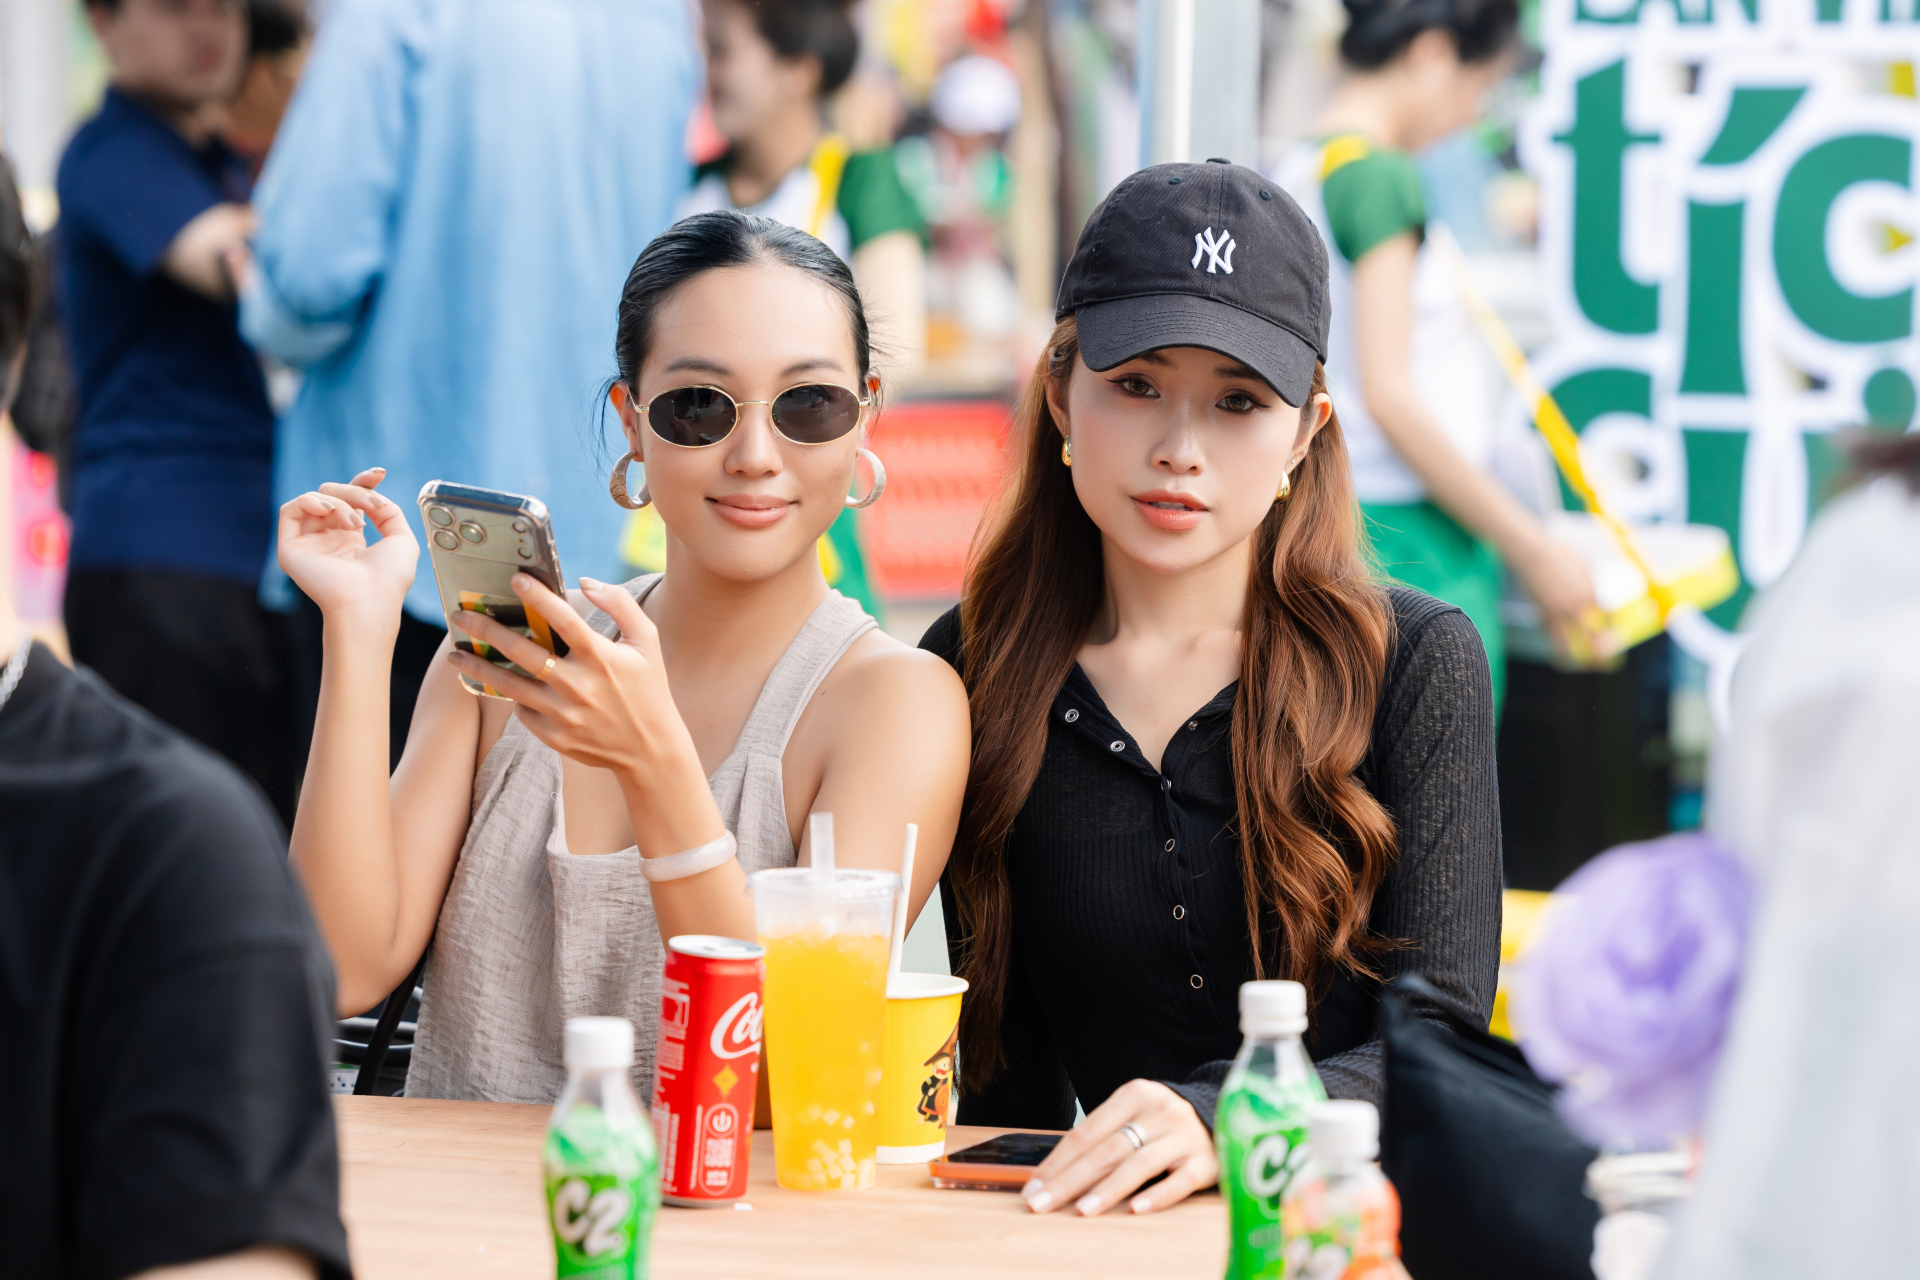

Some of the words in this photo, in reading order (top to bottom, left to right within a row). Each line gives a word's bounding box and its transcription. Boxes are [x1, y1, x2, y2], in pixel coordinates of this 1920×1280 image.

[1191, 226, 1236, 274] NY
[1247, 1134, 1311, 1198] C
[555, 1179, 629, 1256] C2
